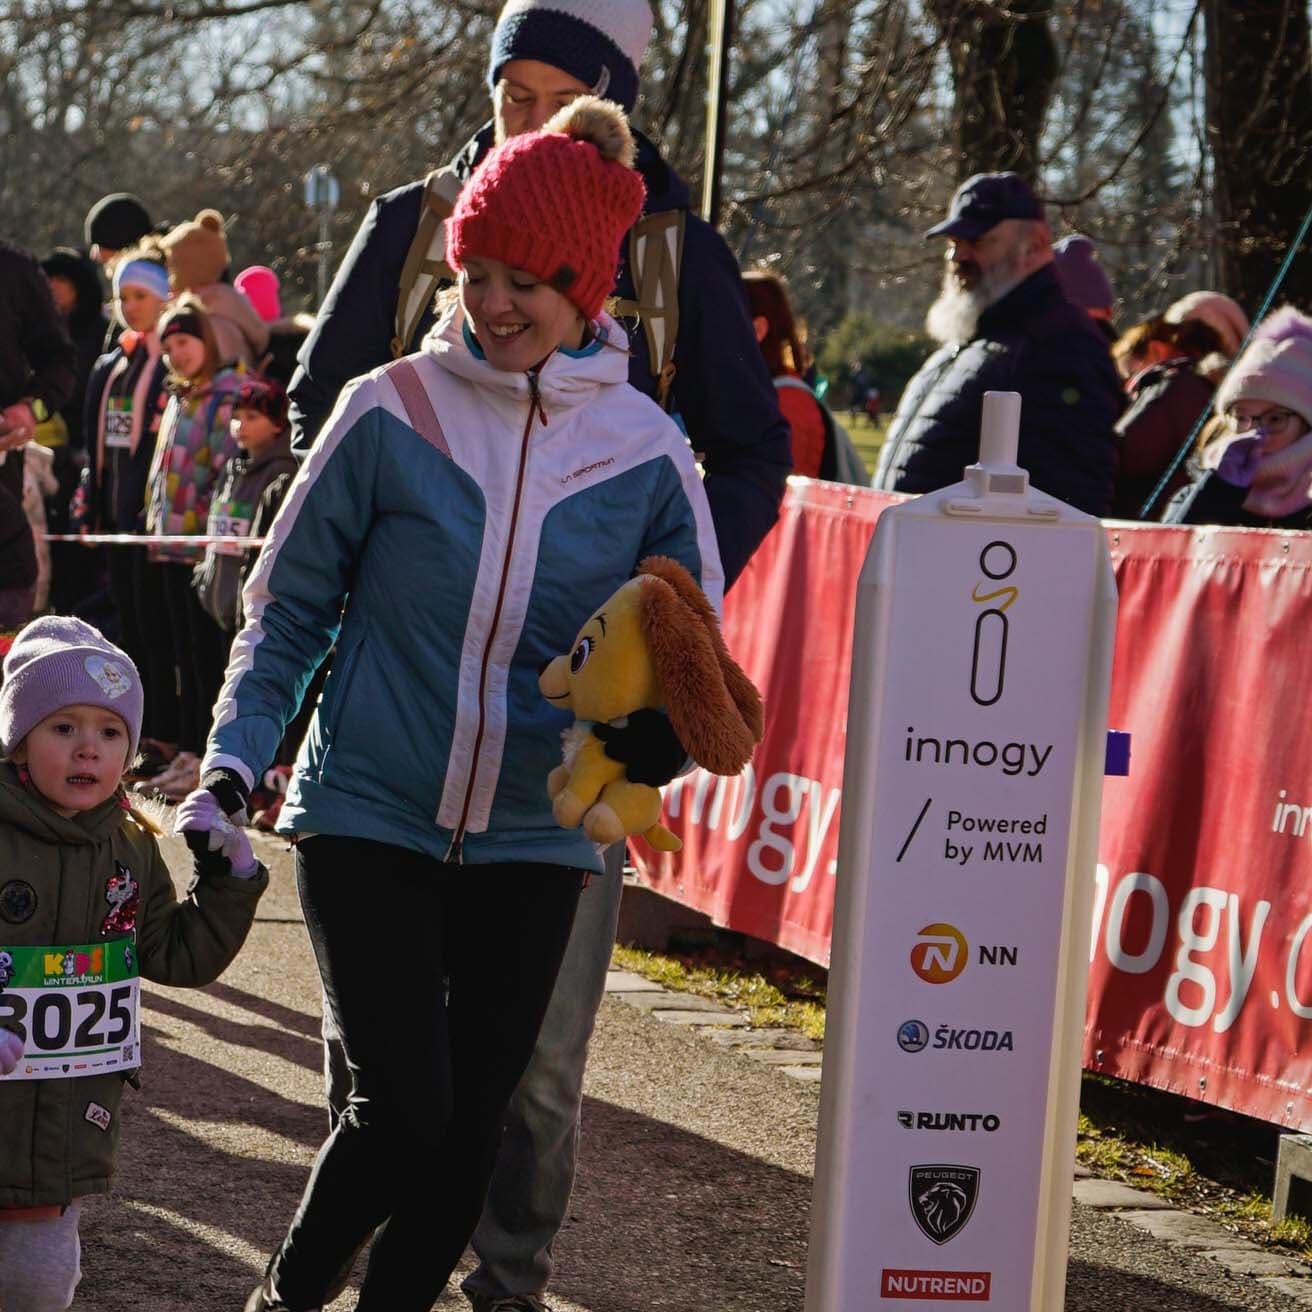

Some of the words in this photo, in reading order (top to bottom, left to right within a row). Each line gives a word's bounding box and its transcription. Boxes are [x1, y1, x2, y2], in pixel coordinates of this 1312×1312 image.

[905, 726, 1054, 776] innogy
[947, 811, 1048, 835] Powered
[944, 838, 973, 865] by
[983, 841, 1043, 863] MVM
[978, 945, 1018, 967] NN
[933, 1024, 1014, 1052] ŠKODA
[917, 1112, 1000, 1132] RUNTO
[916, 1171, 974, 1181] PEUGEOT
[888, 1275, 986, 1296] NUTREND
